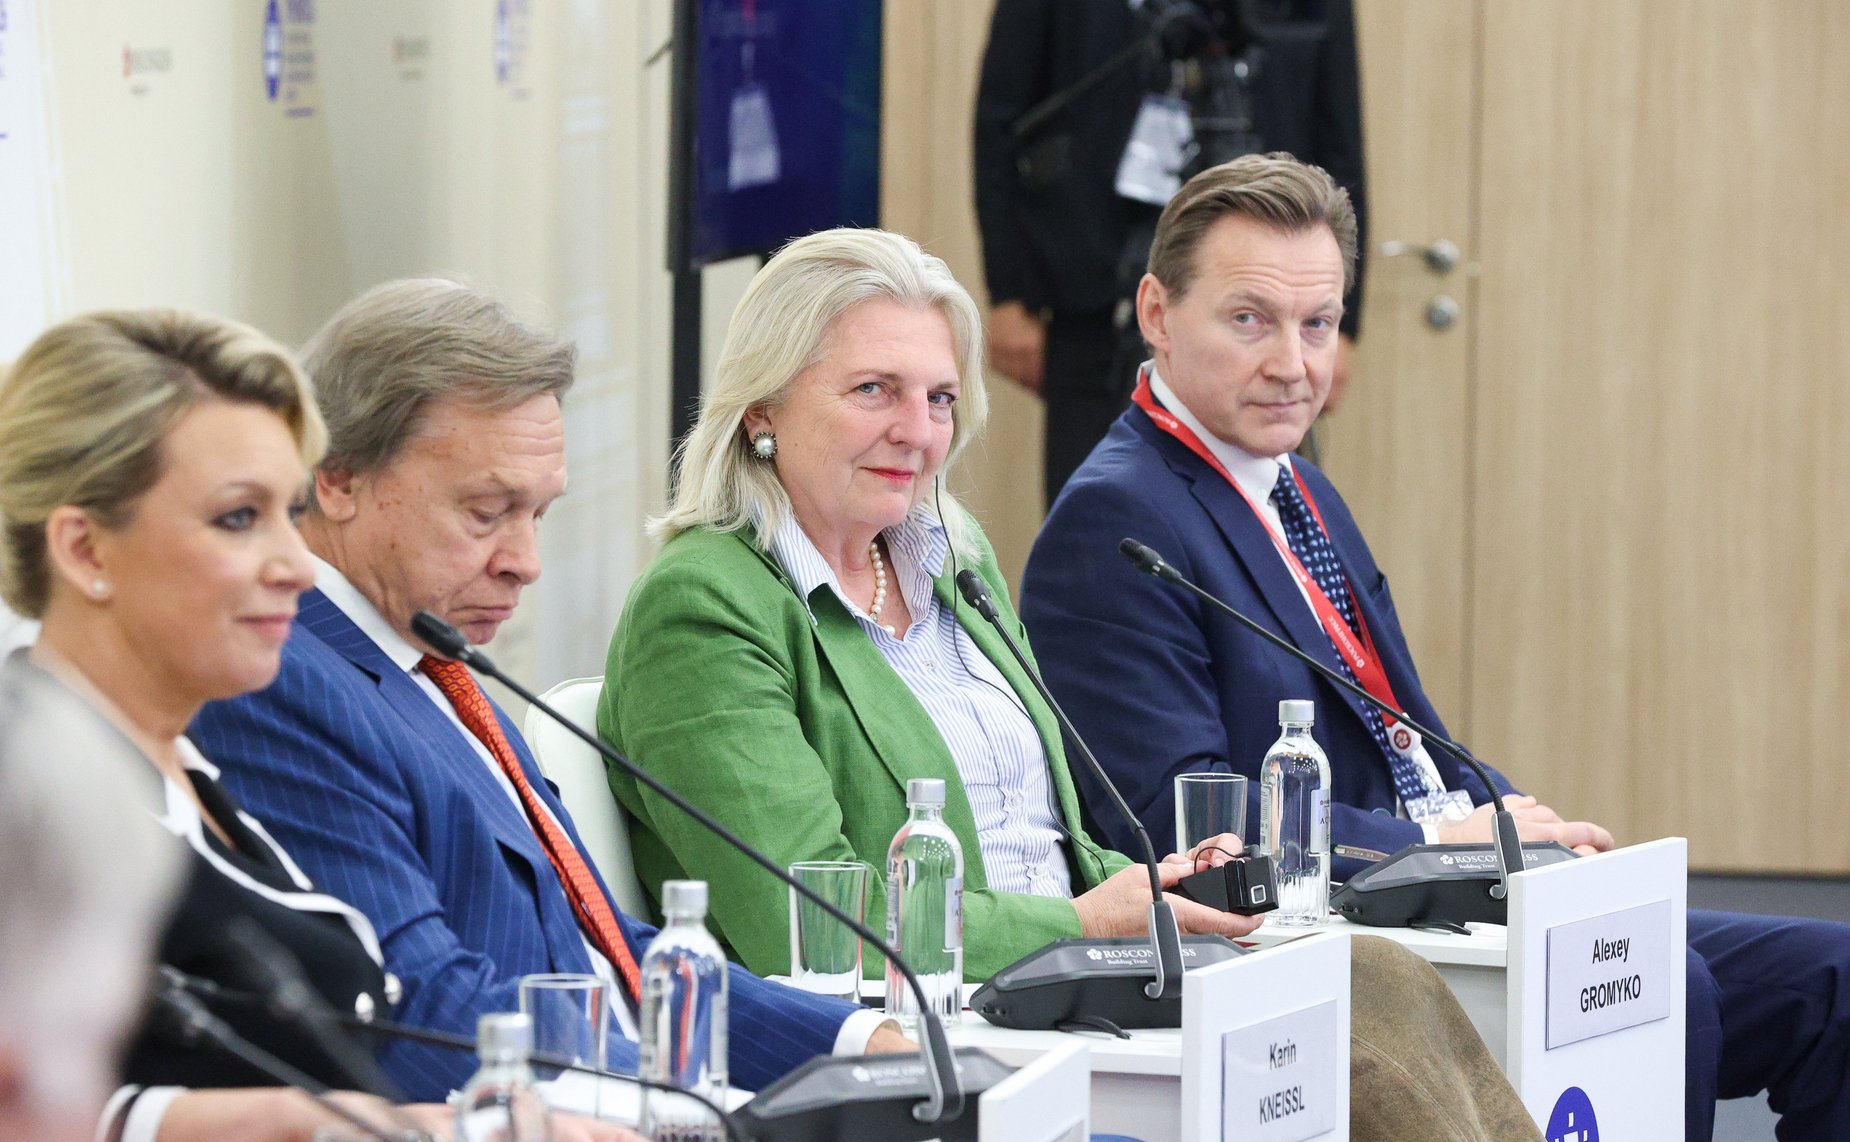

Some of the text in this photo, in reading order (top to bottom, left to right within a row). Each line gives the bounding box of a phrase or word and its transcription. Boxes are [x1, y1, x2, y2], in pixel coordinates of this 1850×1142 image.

[1455, 853, 1538, 863] ROSCOSS
[1103, 948, 1197, 959] ROSCONSS
[1592, 937, 1630, 964] Alexey
[1580, 974, 1641, 1013] GROMYKO
[1269, 1038, 1297, 1070] Karin
[1259, 1085, 1305, 1125] KNEISSL
